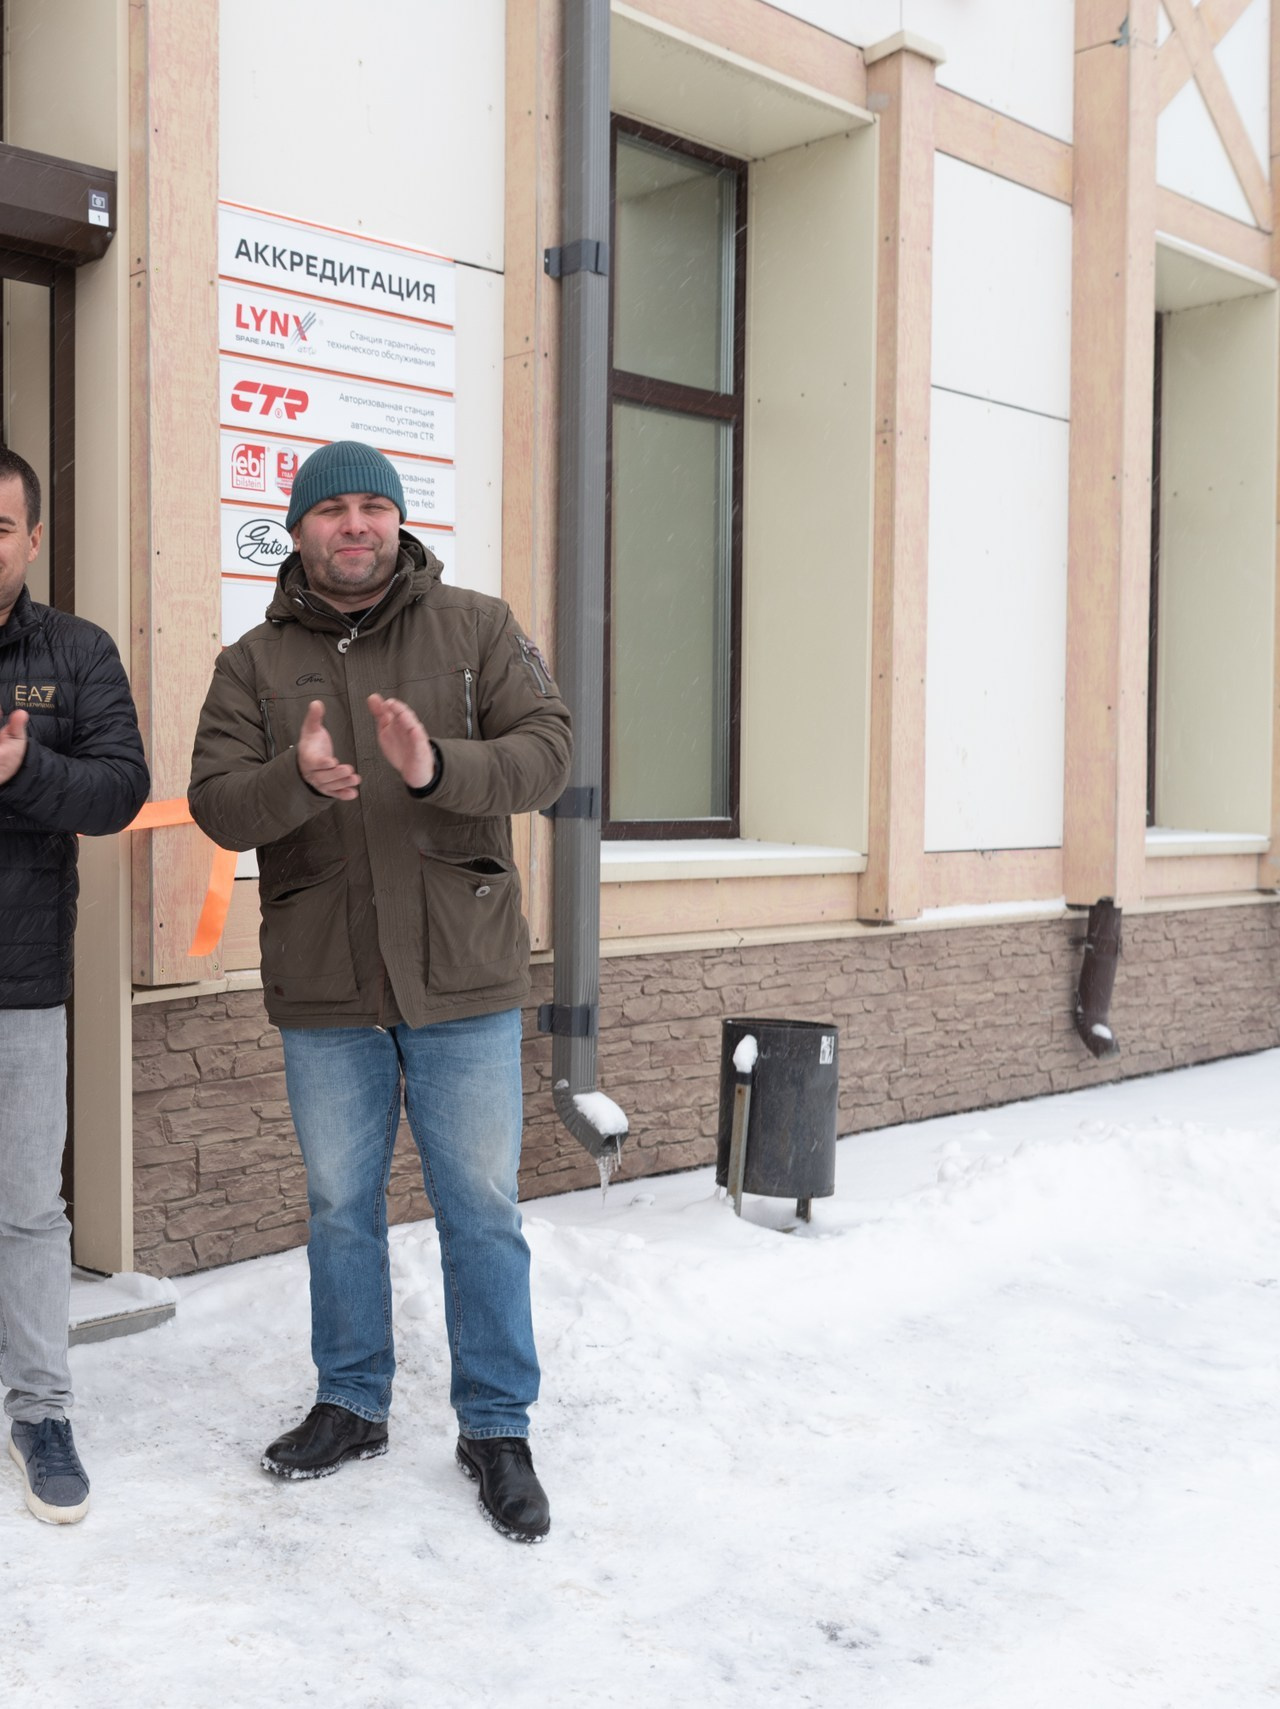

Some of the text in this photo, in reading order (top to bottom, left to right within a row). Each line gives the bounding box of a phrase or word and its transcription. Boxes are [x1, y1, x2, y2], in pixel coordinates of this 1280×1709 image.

[235, 238, 436, 304] АККРЕДИТАЦИЯ
[235, 303, 317, 344] LYNX
[235, 334, 285, 350] SPARE PARTS
[326, 339, 380, 357] технического
[381, 350, 436, 368] обслуживания
[349, 330, 436, 355] Станция гарантийного
[230, 380, 309, 420] CTR
[339, 393, 435, 417] Авторизованная станция
[350, 421, 418, 439] автокомпонентов
[385, 415, 435, 430] по установке
[231, 445, 265, 478] febi
[280, 447, 295, 471] 3
[235, 476, 261, 488] bilstein
[238, 525, 291, 559] Gates
[15, 685, 56, 703] EA7
